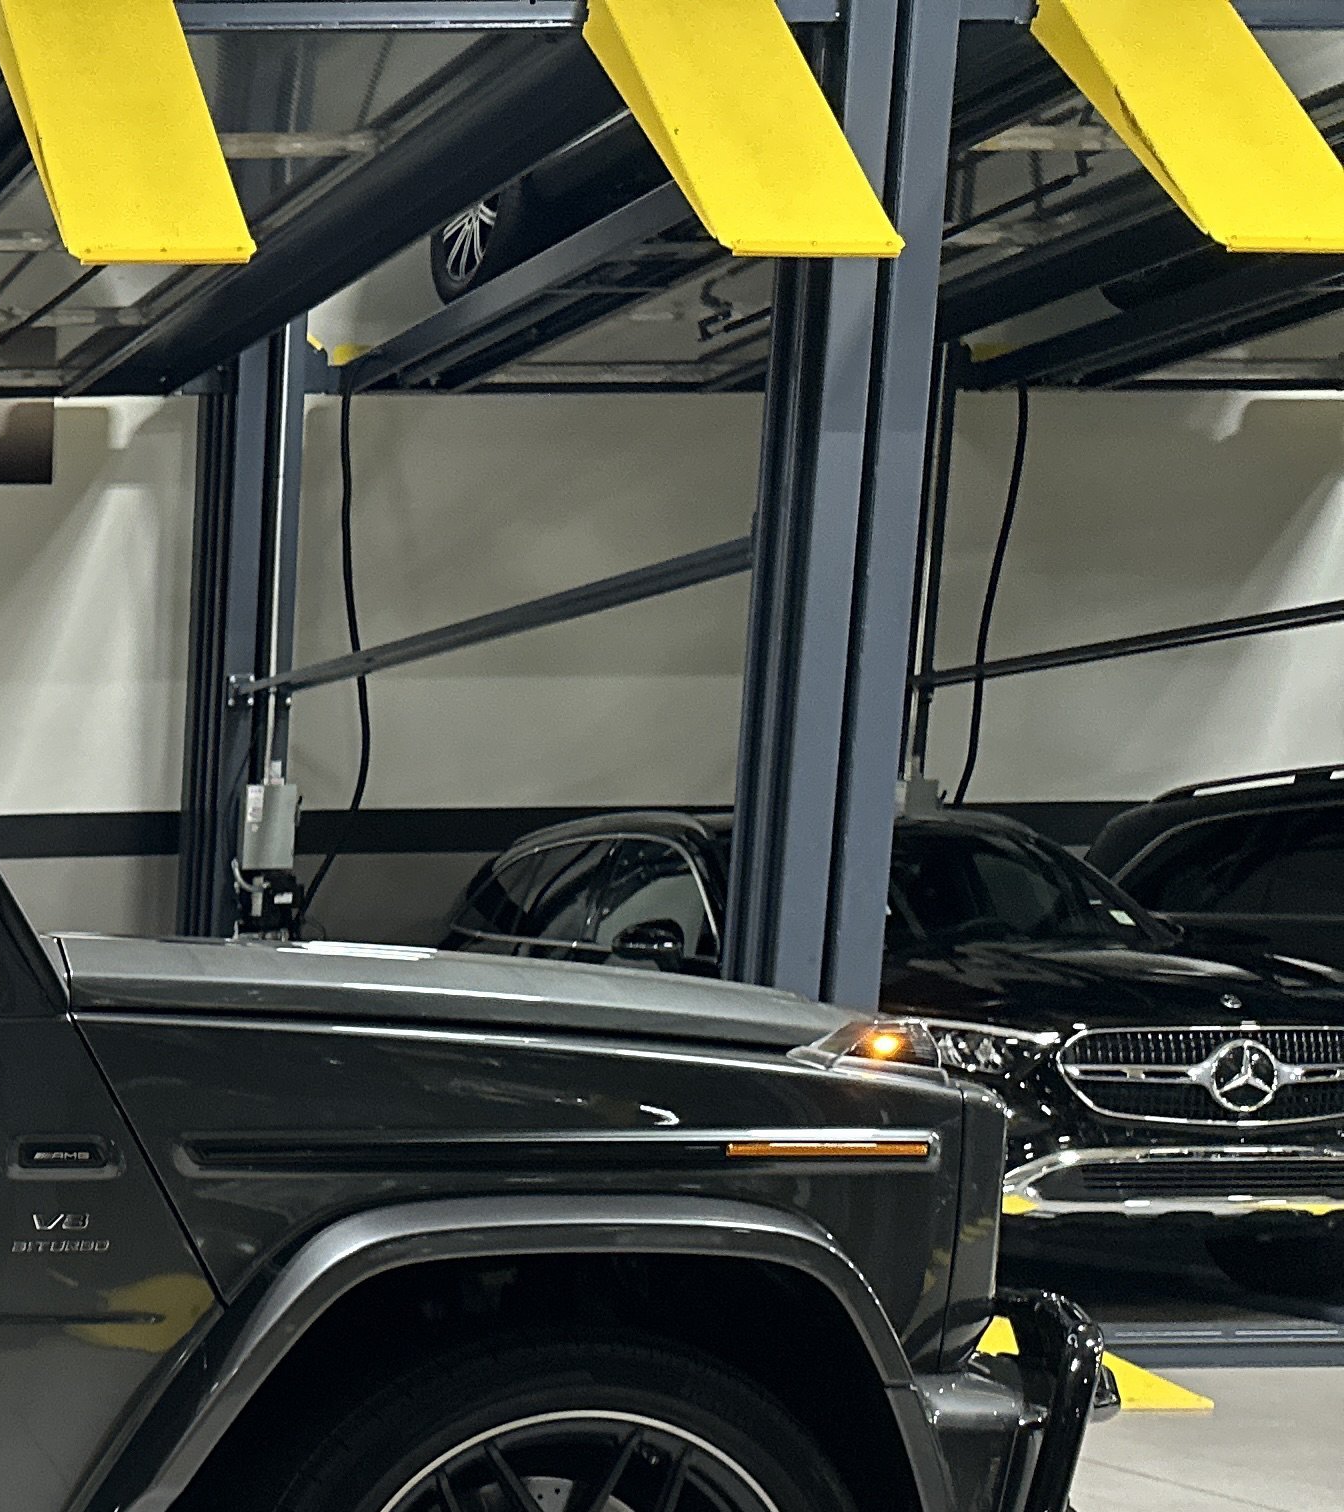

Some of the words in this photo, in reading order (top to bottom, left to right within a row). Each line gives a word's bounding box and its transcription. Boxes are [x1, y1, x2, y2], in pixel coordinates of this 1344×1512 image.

[50, 1151, 90, 1160] AMG
[32, 1212, 90, 1231] V8
[11, 1239, 110, 1252] BITURBO
